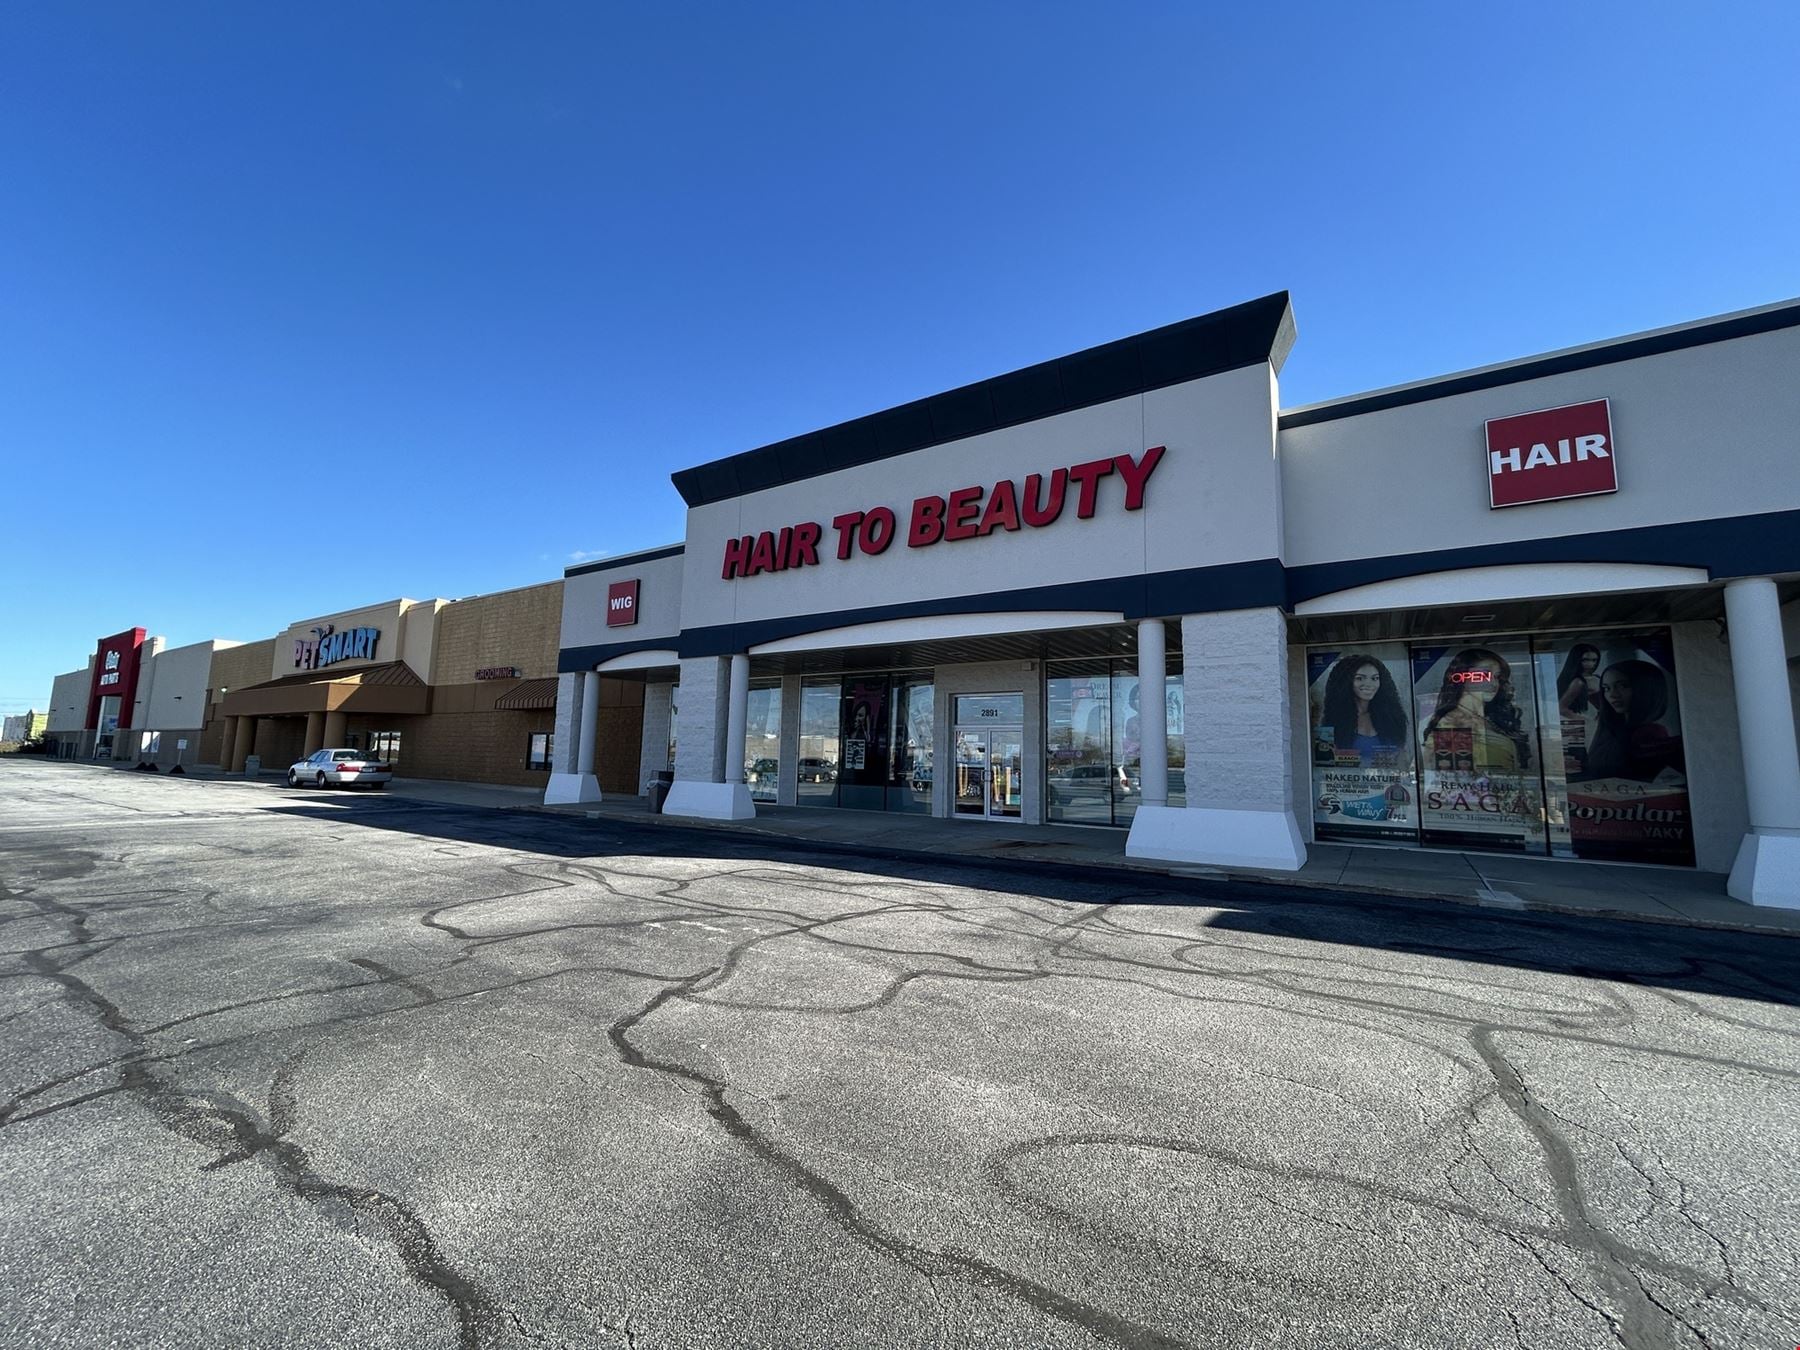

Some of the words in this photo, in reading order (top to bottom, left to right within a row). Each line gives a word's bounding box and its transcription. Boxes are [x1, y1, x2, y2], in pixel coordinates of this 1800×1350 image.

[1491, 434, 1610, 475] HAIR
[722, 521, 821, 580] HAIR
[833, 506, 895, 560] TO
[907, 446, 1166, 548] BEAUTY
[611, 596, 632, 610] WIG
[1451, 671, 1491, 684] OPEN
[981, 709, 998, 717] 2891
[1326, 773, 1359, 782] NAKED
[1362, 775, 1401, 783] NATURE
[1583, 783, 1647, 795] SAGA
[1428, 792, 1532, 814] SAGA
[1567, 801, 1682, 825] Popular
[1644, 826, 1684, 839] YAKY
